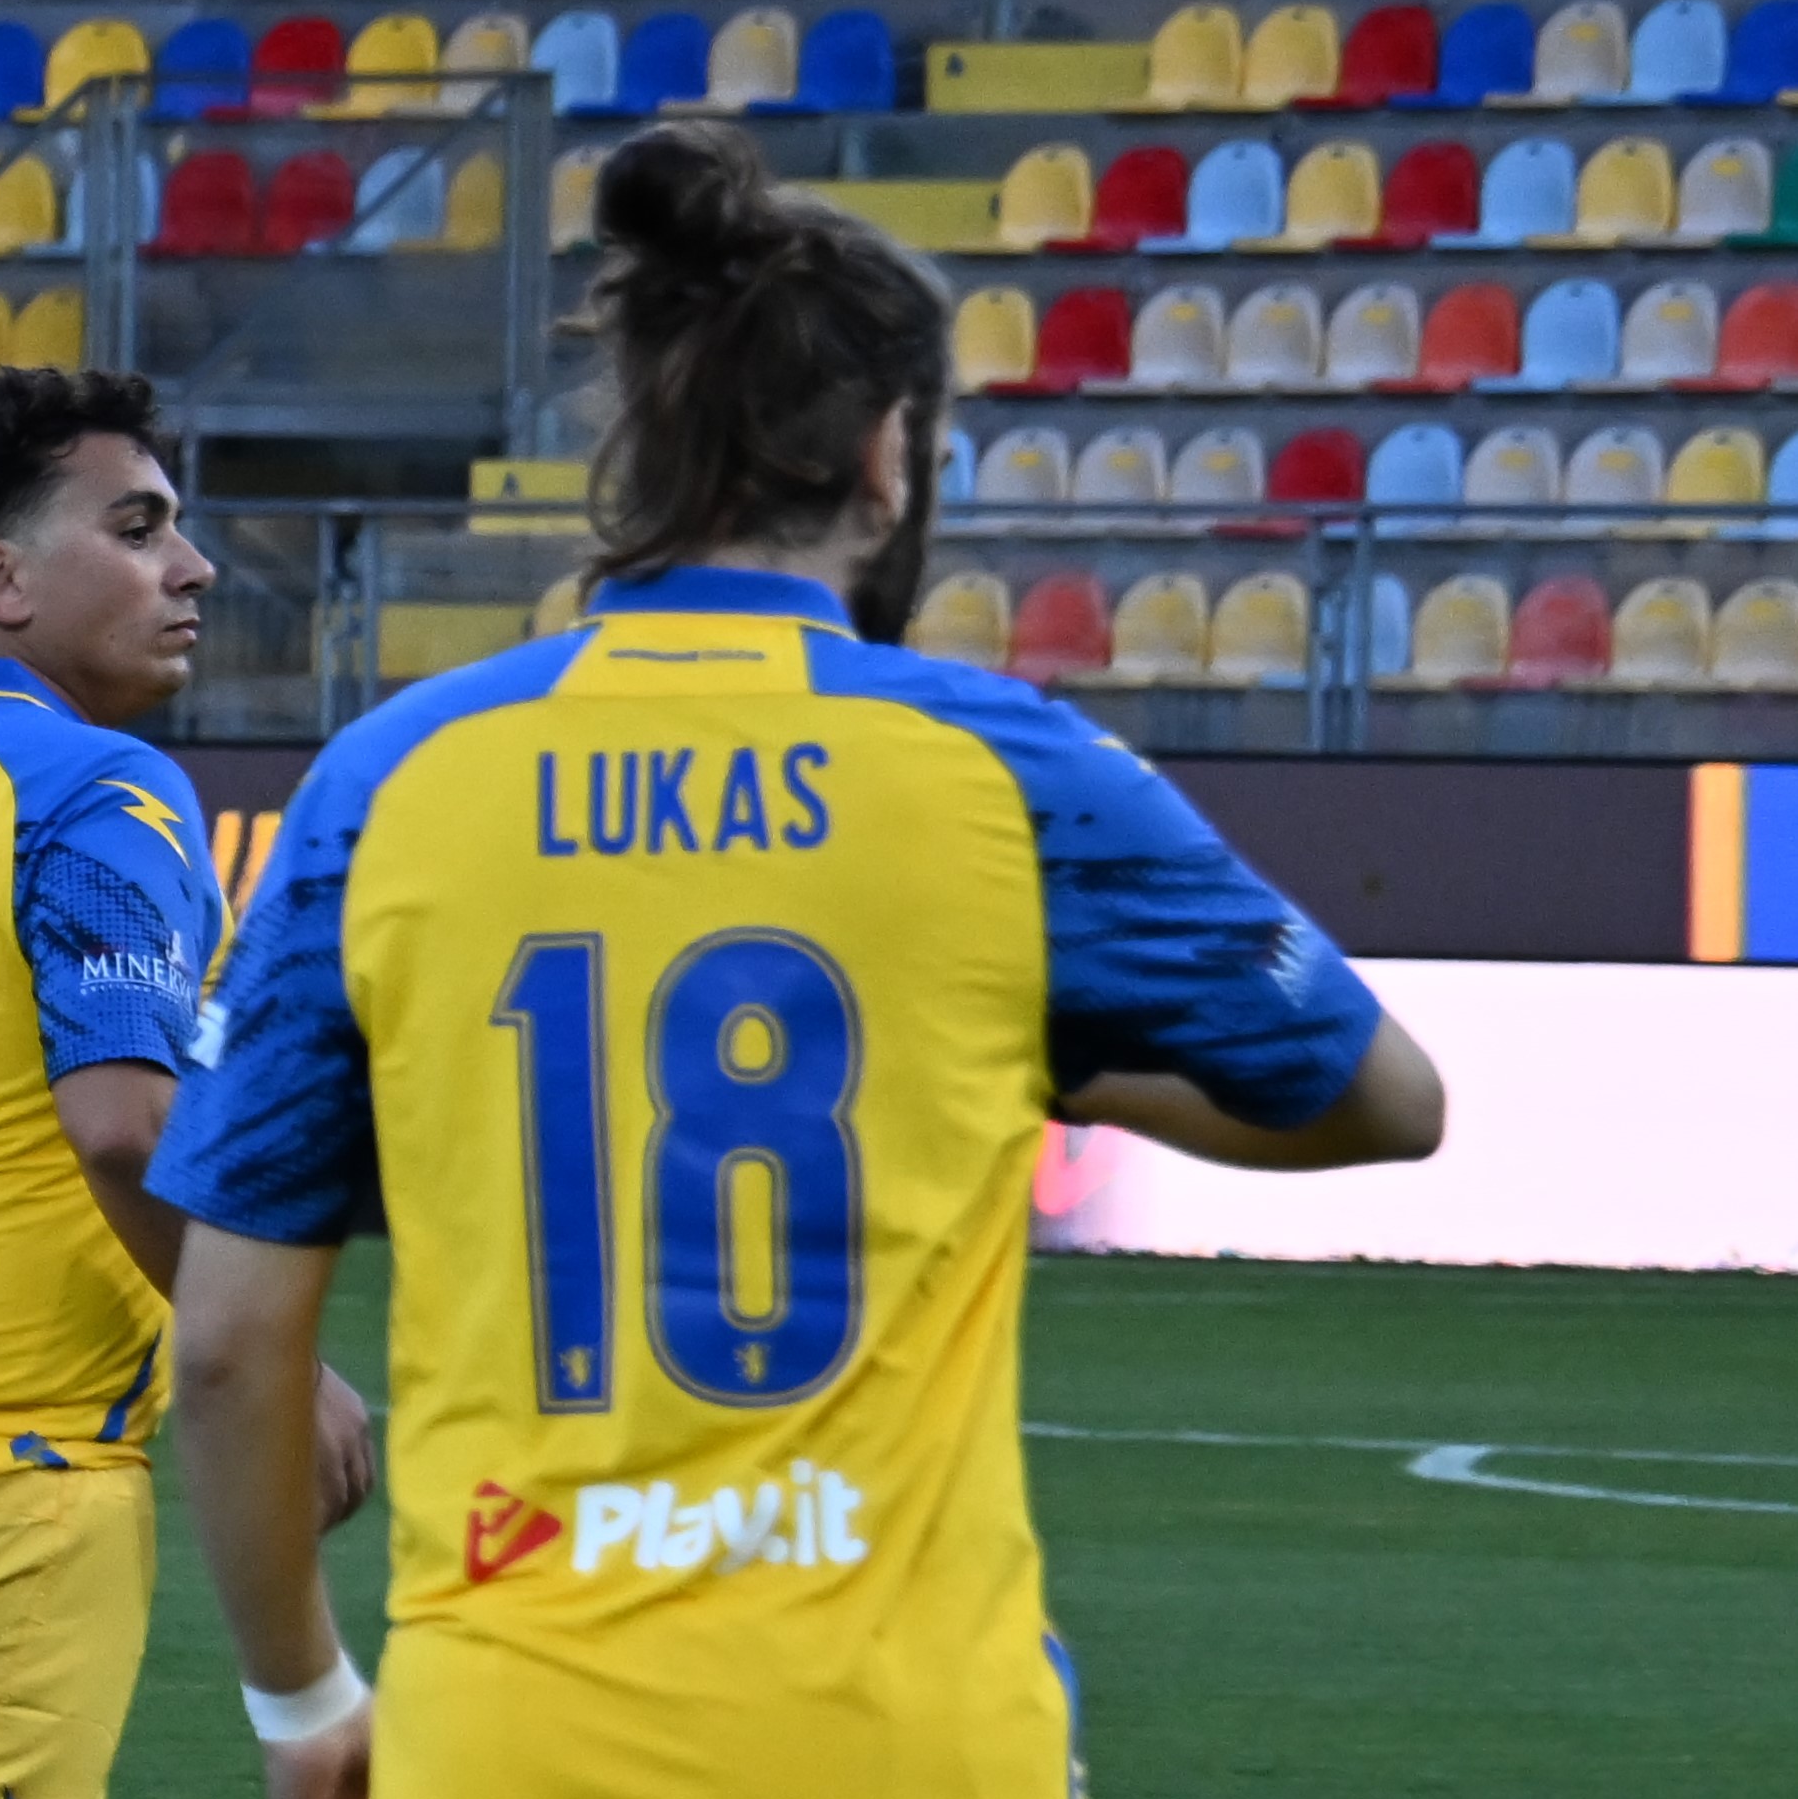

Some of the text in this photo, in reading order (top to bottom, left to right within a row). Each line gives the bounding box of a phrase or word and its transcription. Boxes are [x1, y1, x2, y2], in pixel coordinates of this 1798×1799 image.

[537, 742, 830, 856] LUKAS
[490, 926, 862, 1415] 18
[572, 1459, 868, 1575] Play.it
